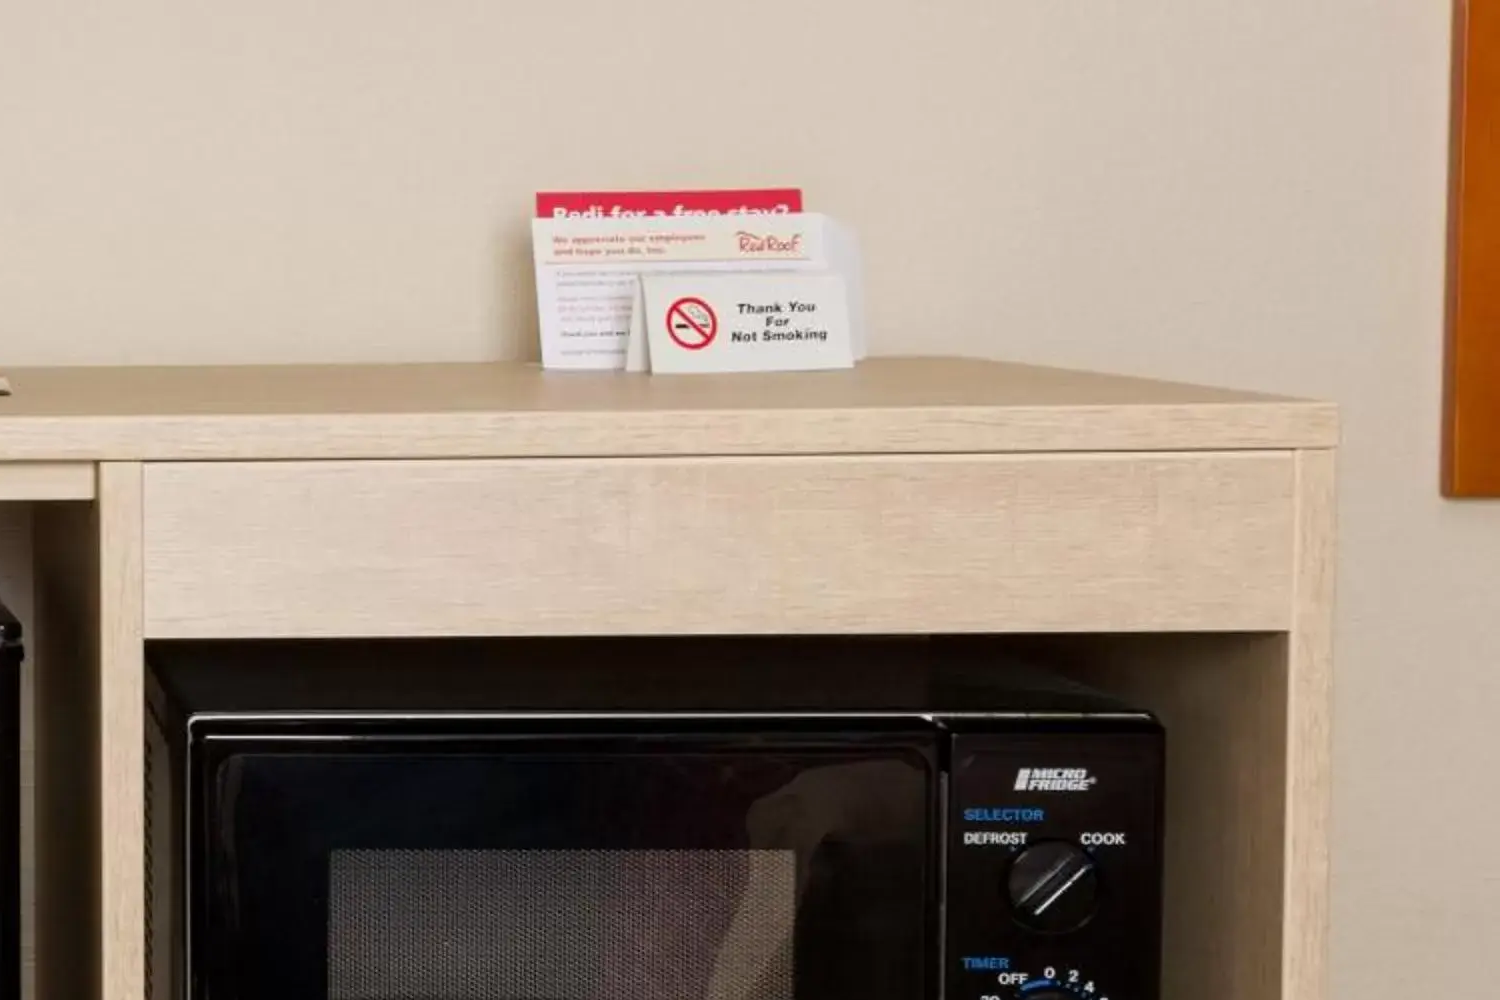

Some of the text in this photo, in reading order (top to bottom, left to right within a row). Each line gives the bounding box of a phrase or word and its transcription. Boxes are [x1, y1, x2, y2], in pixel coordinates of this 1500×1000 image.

[737, 301, 816, 314] Thank You
[765, 316, 790, 327] For
[731, 329, 828, 342] Not Smoking
[1031, 767, 1087, 779] MICRO
[963, 808, 1044, 821] SELECTOR
[964, 831, 1028, 845] DEFROST
[1080, 832, 1127, 845] COOK
[962, 957, 1010, 969] TIMER
[998, 973, 1029, 985] OFF
[1043, 966, 1055, 979] 0
[1068, 969, 1080, 983] 2
[1084, 981, 1095, 993] 4
